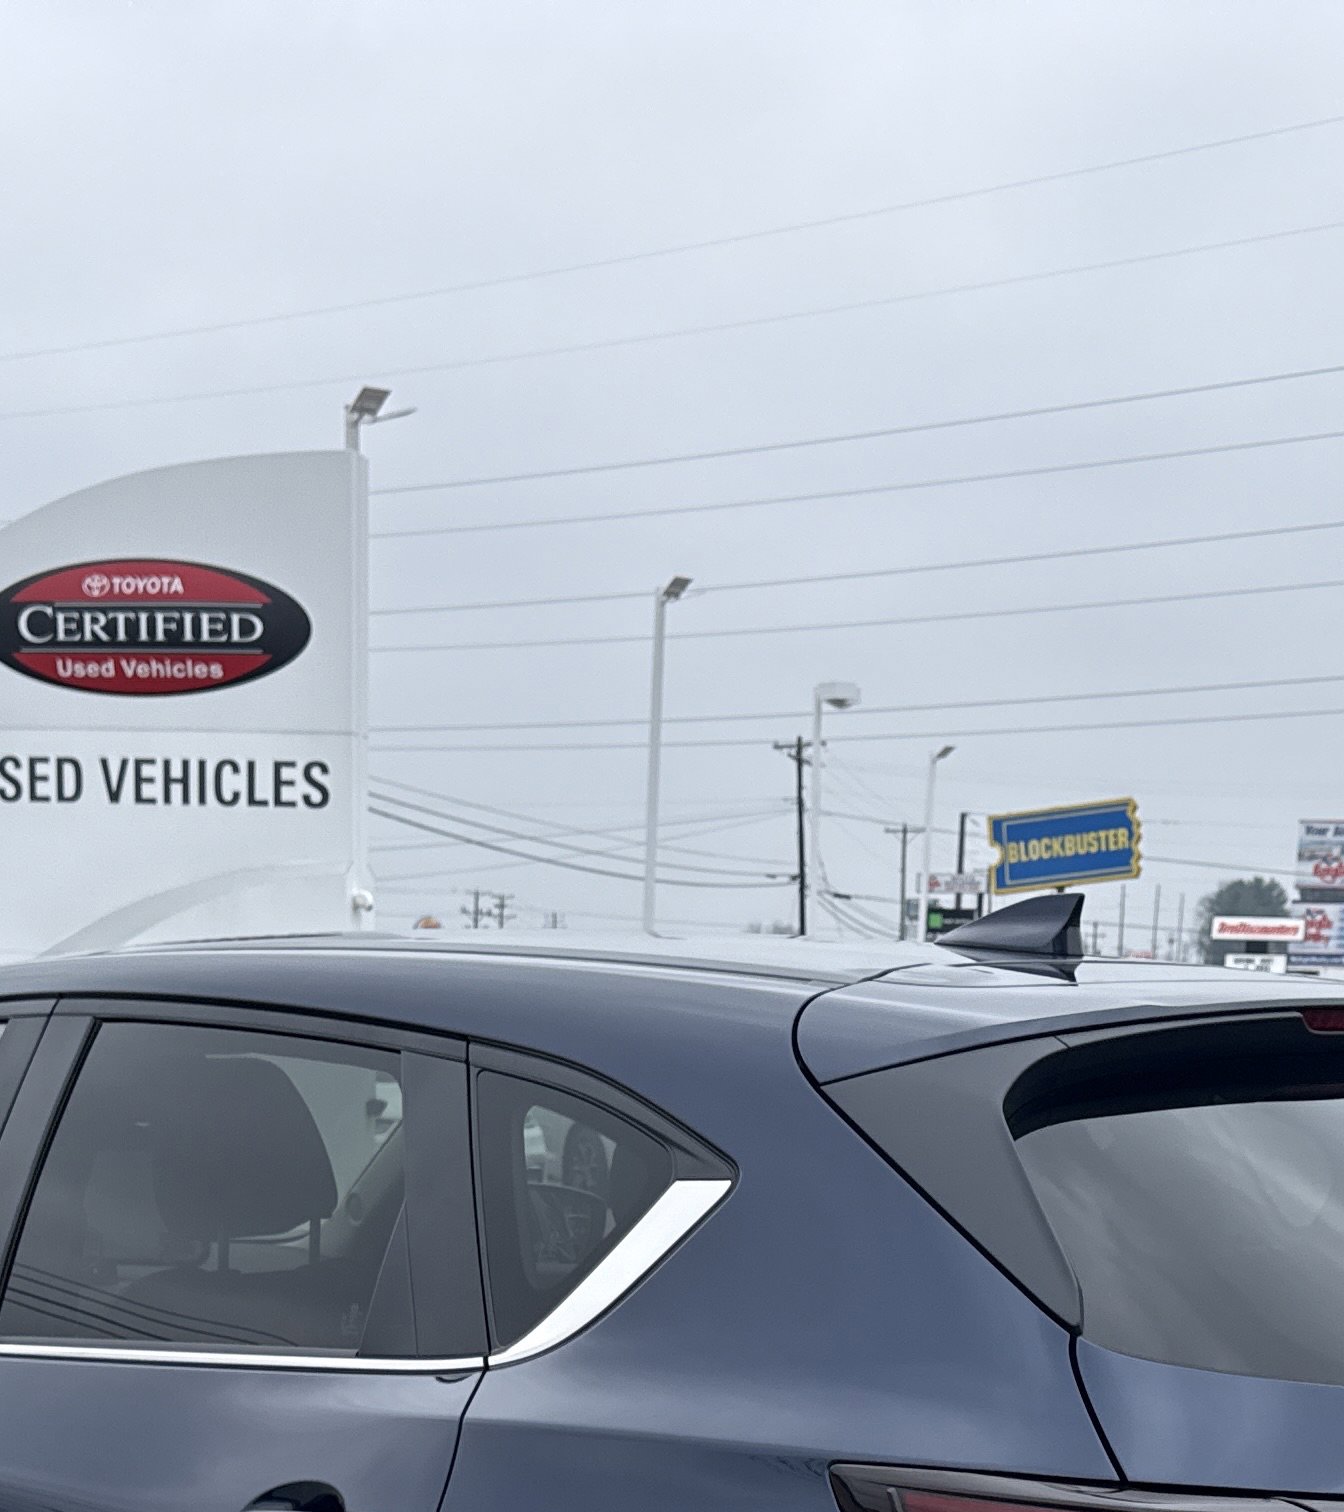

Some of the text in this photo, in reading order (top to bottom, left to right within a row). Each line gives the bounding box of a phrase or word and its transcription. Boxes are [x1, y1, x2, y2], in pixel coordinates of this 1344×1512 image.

[112, 575, 184, 595] TOYOTA
[18, 603, 264, 645] CERTIFIED
[56, 657, 224, 680] Used Vehicles
[100, 757, 331, 810] VEHICLES
[1007, 826, 1129, 864] BLOCKBUSTER
